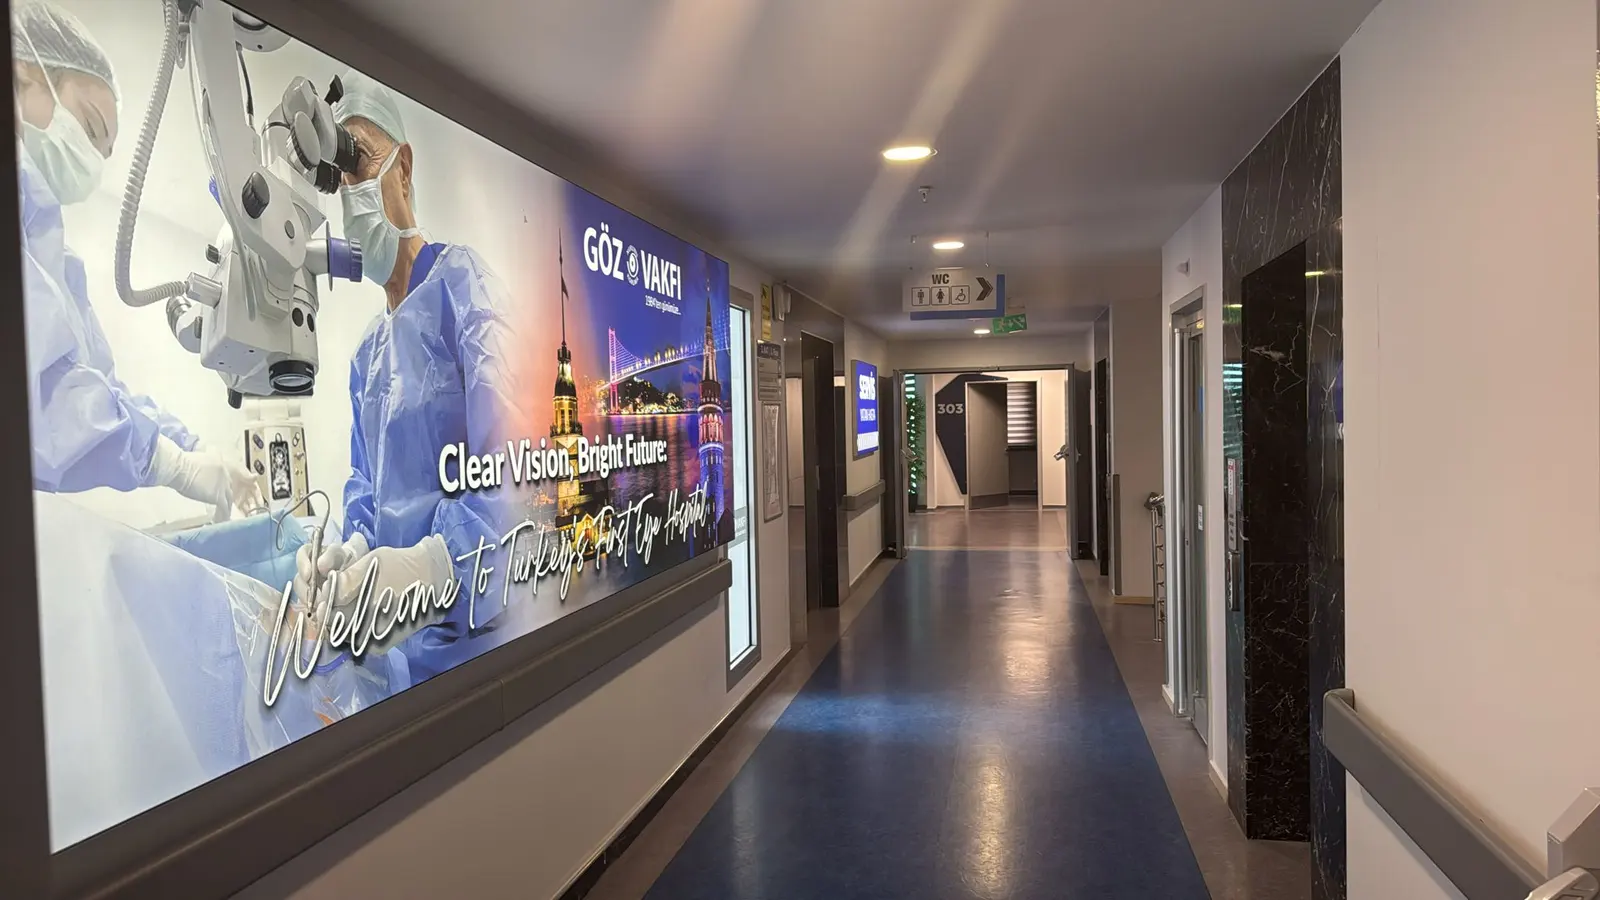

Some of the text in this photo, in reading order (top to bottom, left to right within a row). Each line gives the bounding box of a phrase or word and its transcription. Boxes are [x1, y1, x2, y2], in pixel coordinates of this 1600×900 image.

[583, 221, 625, 281] GÖZ
[640, 249, 682, 300] VAKFI
[931, 273, 950, 285] WC
[937, 403, 964, 414] 303
[438, 433, 668, 493] Clear Vision, Bright Future:
[264, 481, 708, 706] Welcome to Turkey's First Eye Hospital
